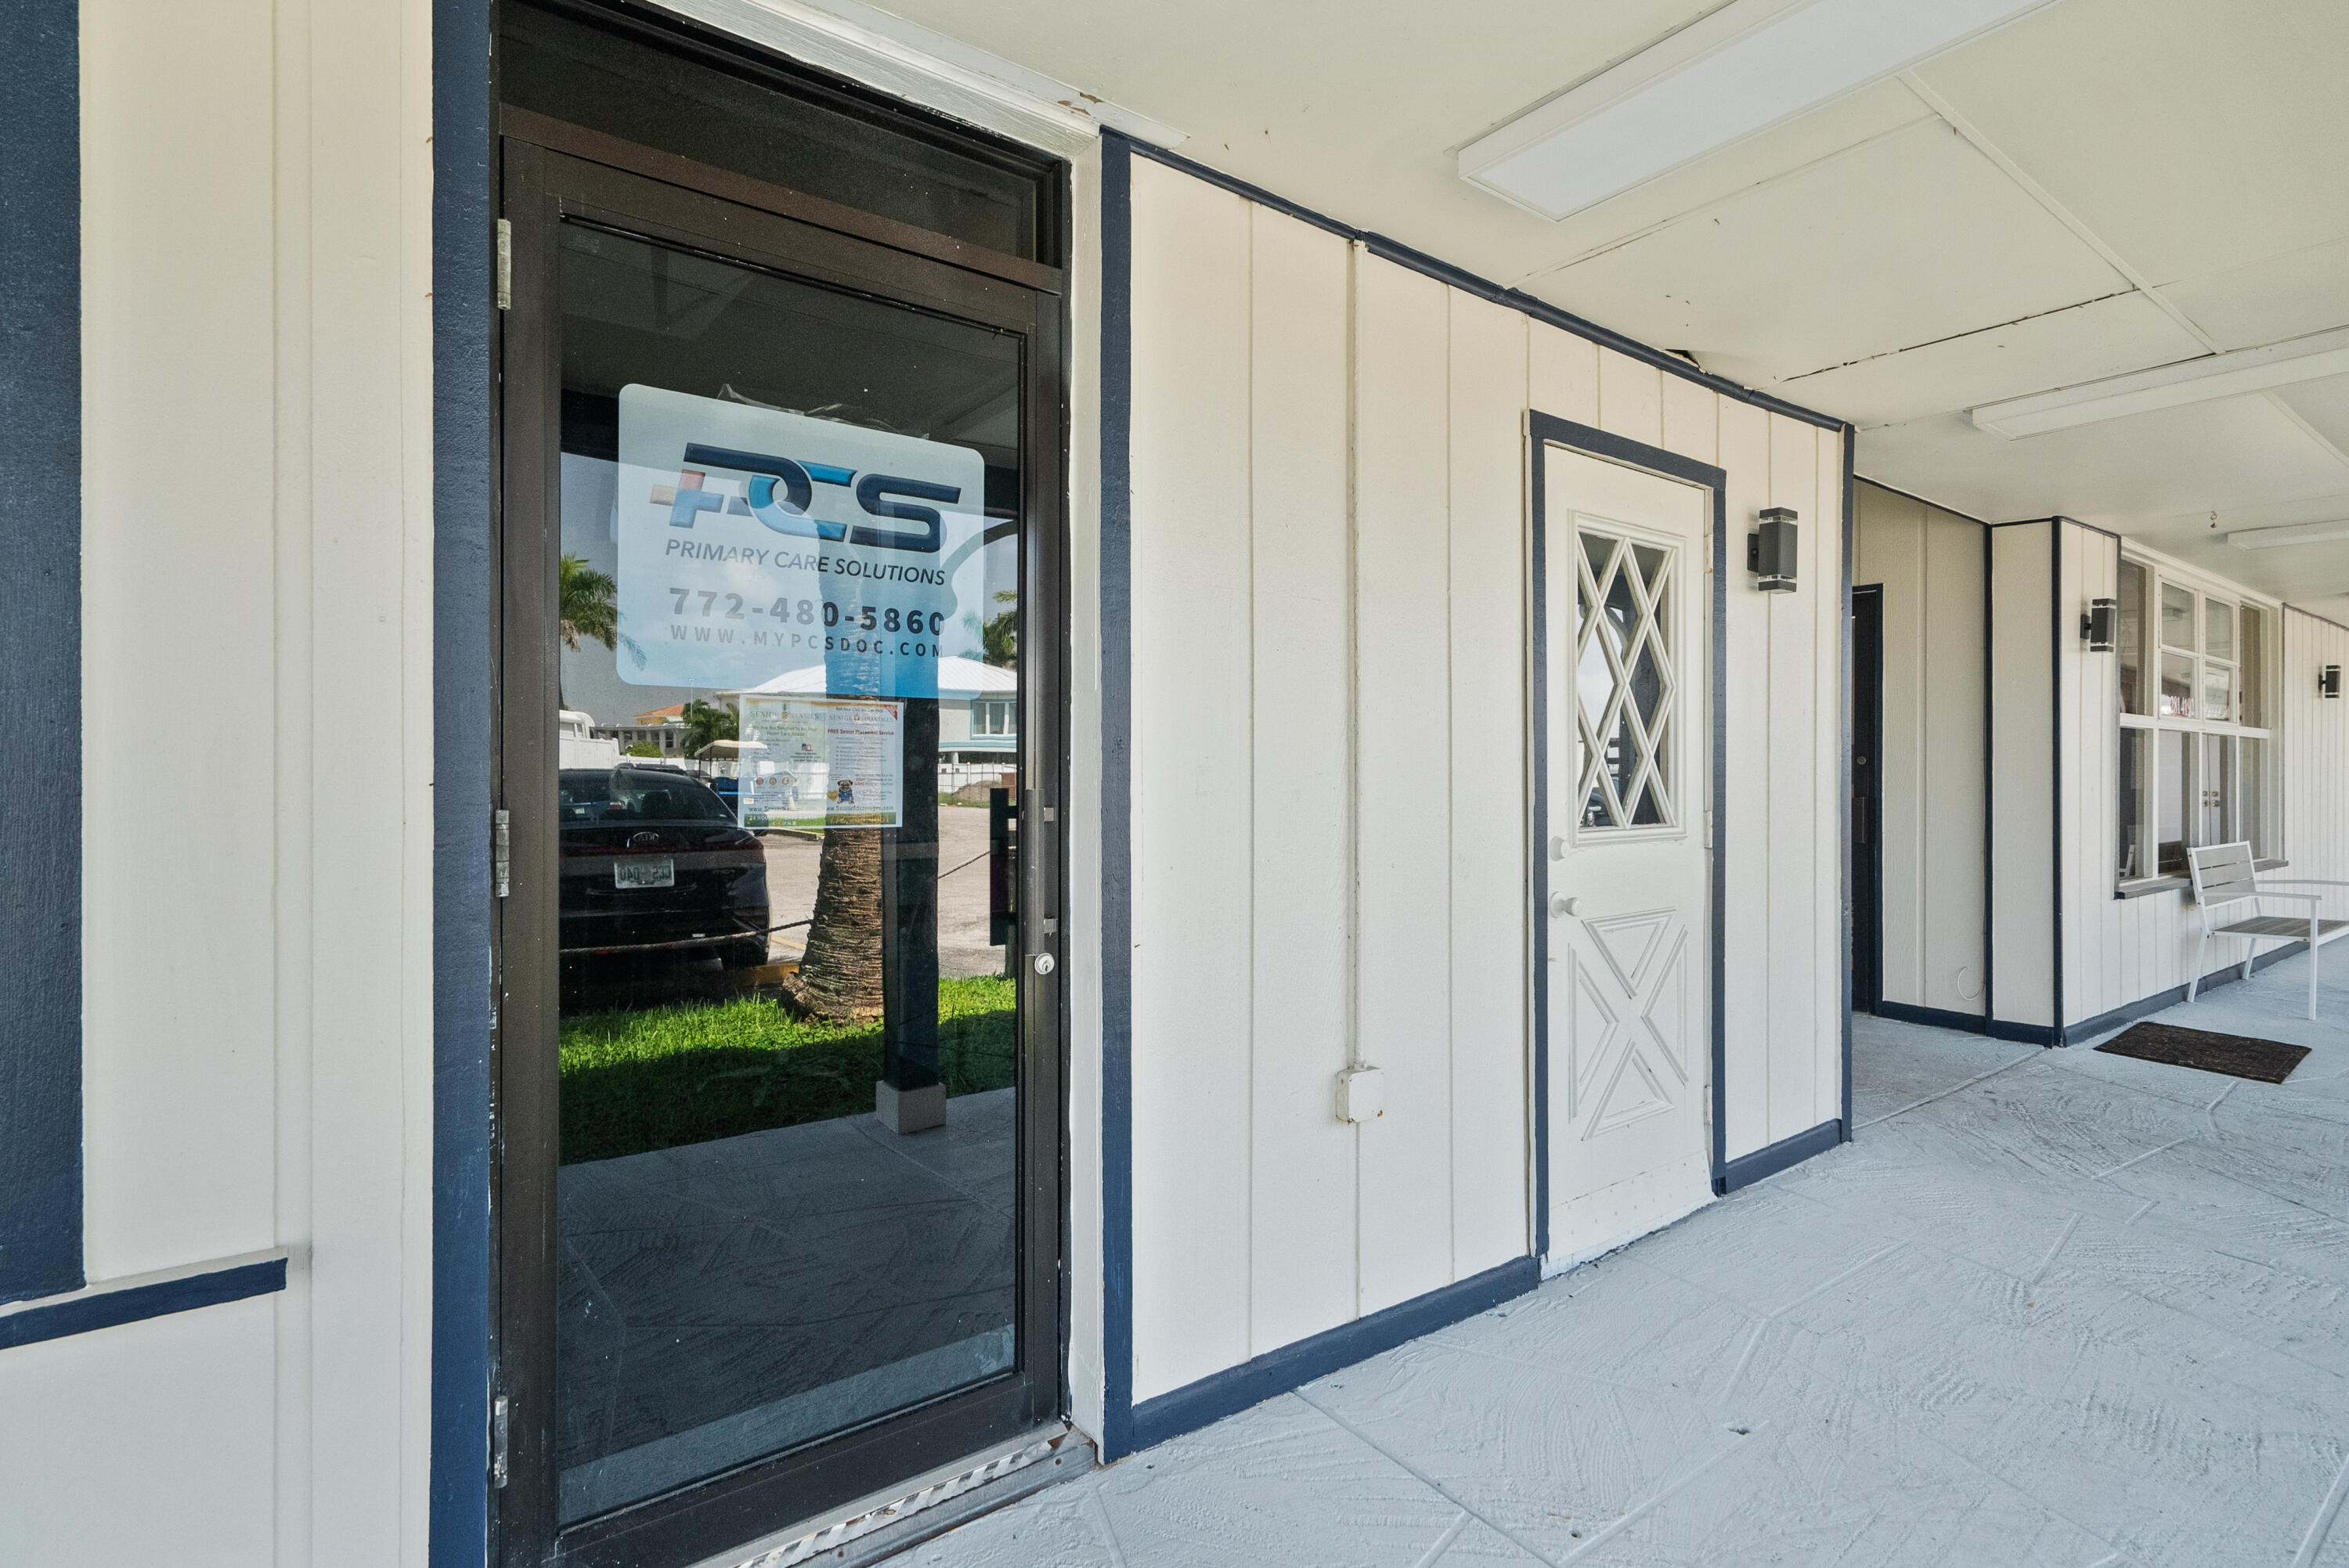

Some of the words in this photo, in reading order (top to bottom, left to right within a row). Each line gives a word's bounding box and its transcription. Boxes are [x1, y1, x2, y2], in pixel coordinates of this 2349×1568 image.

[683, 442, 962, 553] PCS
[666, 538, 770, 565] PRIMARY
[774, 551, 830, 573] CARE
[834, 558, 946, 586] SOLUTIONS
[669, 587, 945, 636] 772-480-5860
